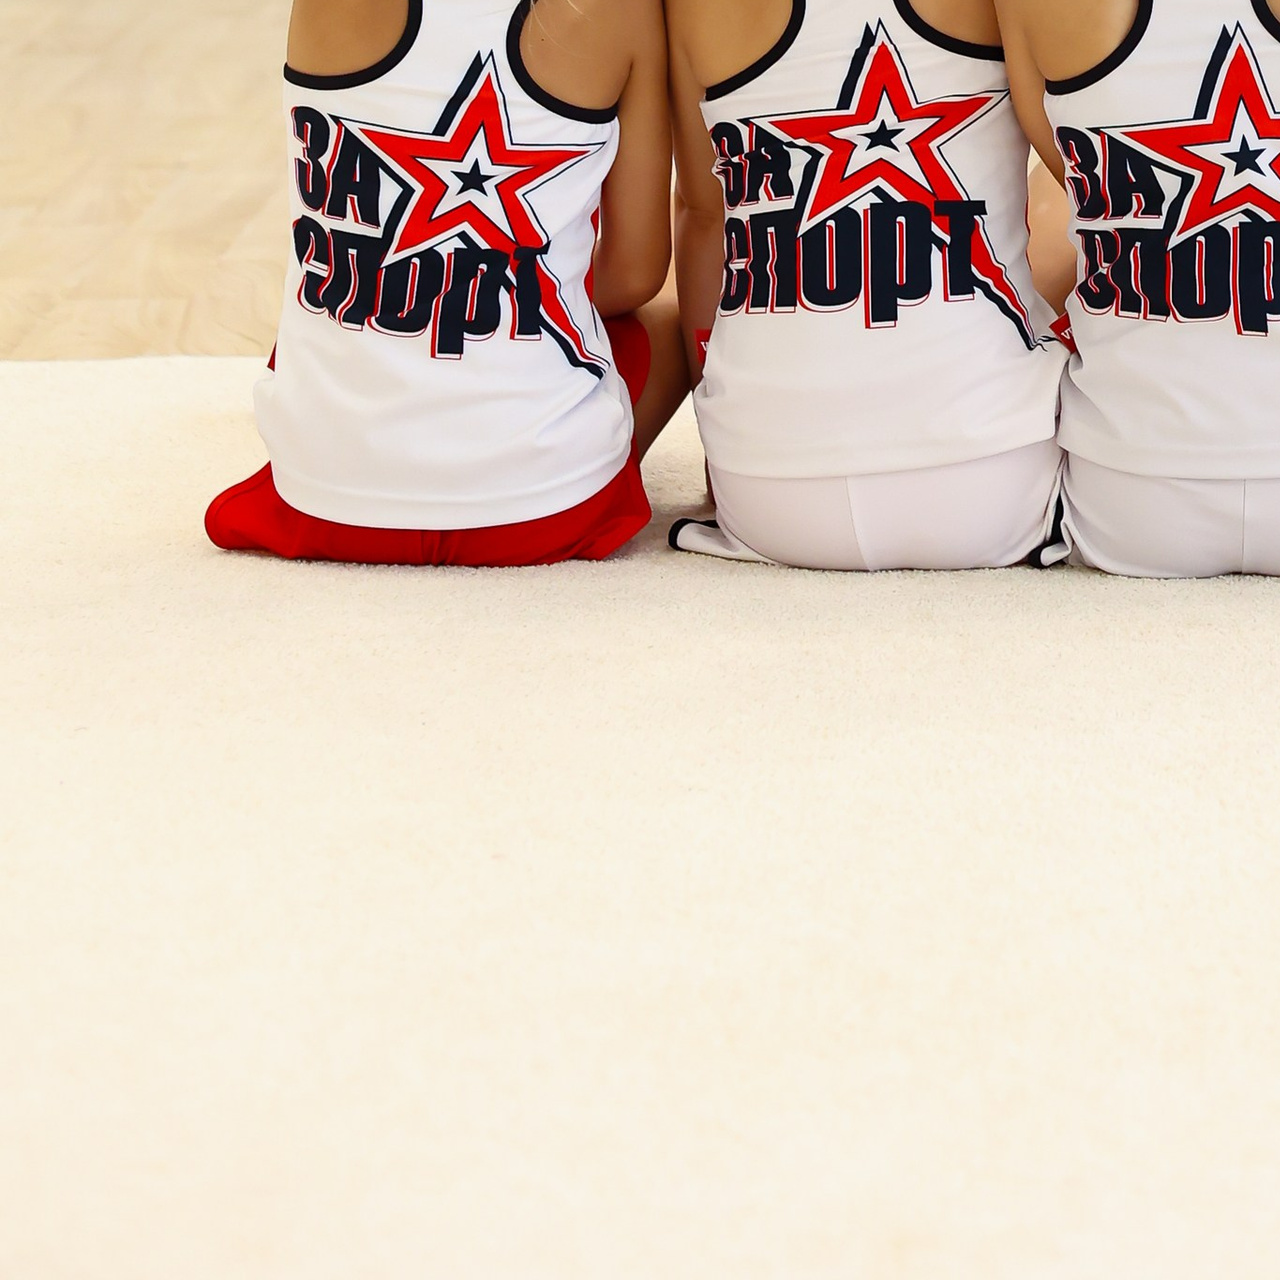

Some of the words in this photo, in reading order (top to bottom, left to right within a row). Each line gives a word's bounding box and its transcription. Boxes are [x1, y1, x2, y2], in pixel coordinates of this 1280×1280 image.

[291, 106, 381, 228] ЗА
[710, 121, 795, 211] ЗА
[1055, 126, 1165, 221] ЗА
